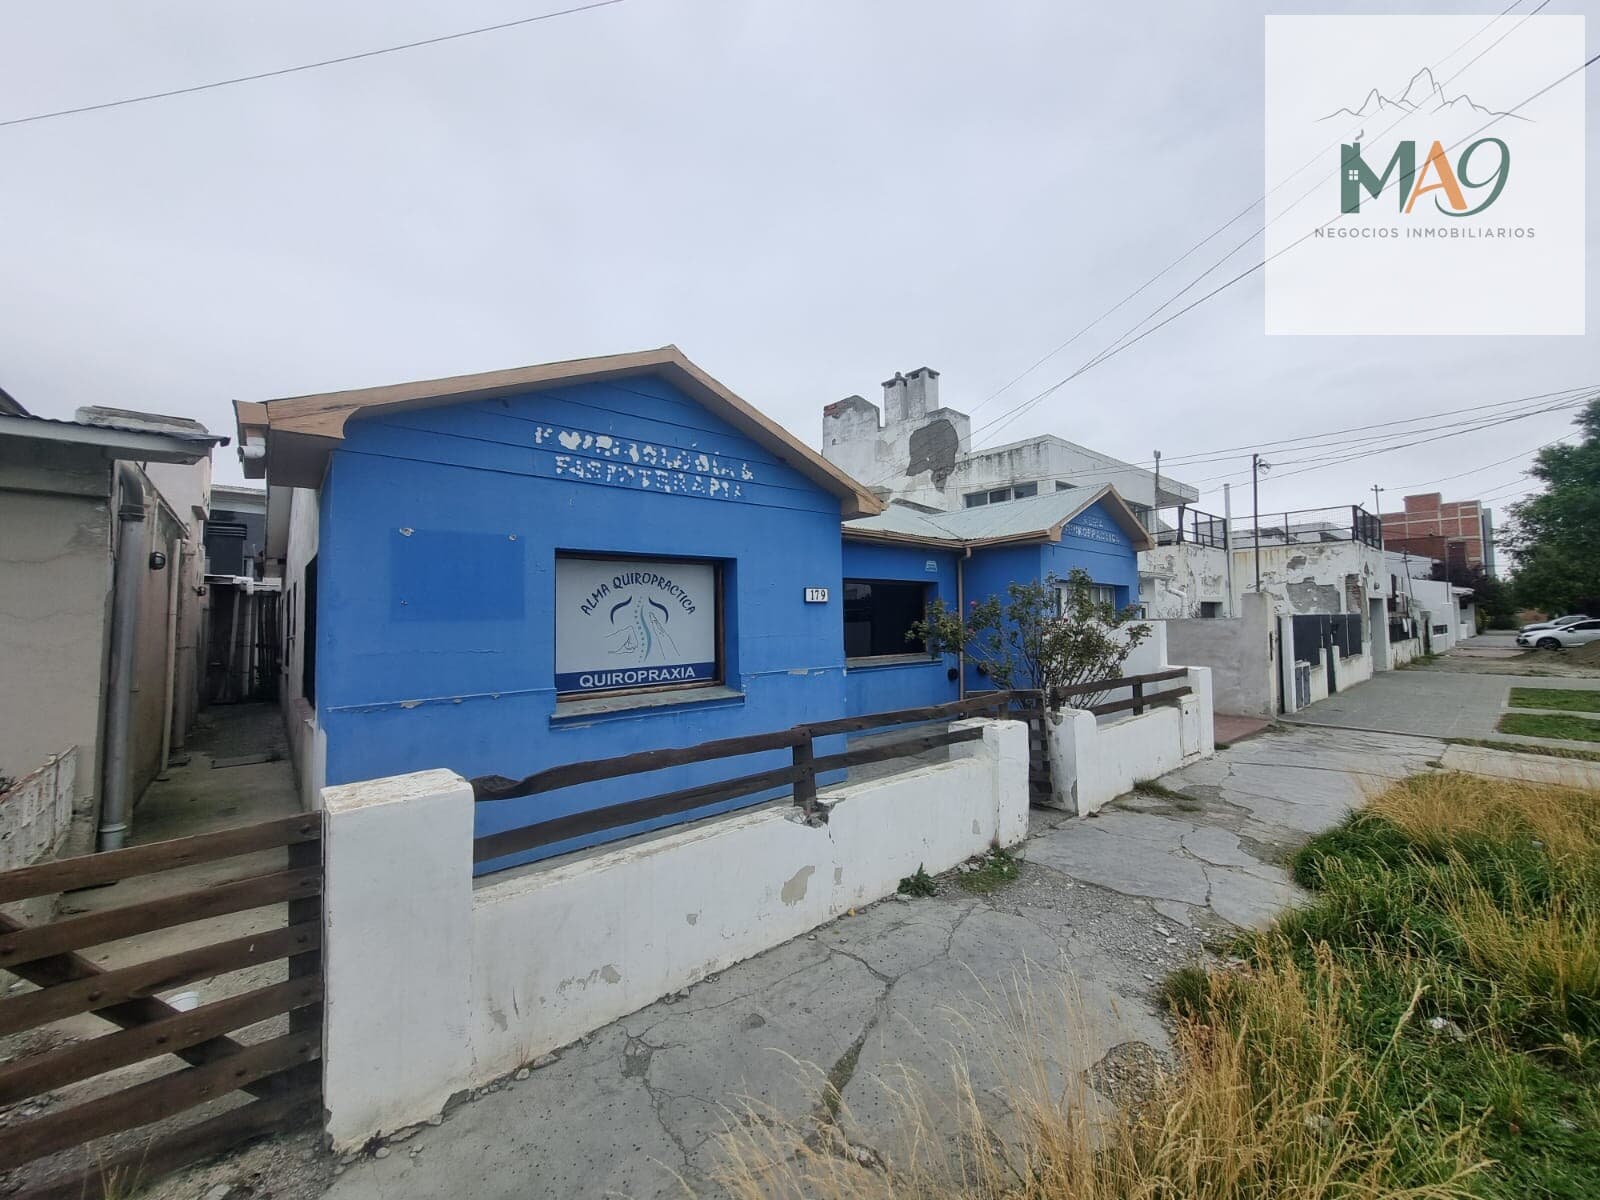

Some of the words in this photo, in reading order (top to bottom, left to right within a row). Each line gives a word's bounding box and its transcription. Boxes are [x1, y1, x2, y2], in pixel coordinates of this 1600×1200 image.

[580, 583, 610, 616] ALMA
[612, 572, 696, 615] QUIROPRACTICA
[810, 590, 826, 600] 179
[579, 666, 696, 688] QUIROPRAXIA
